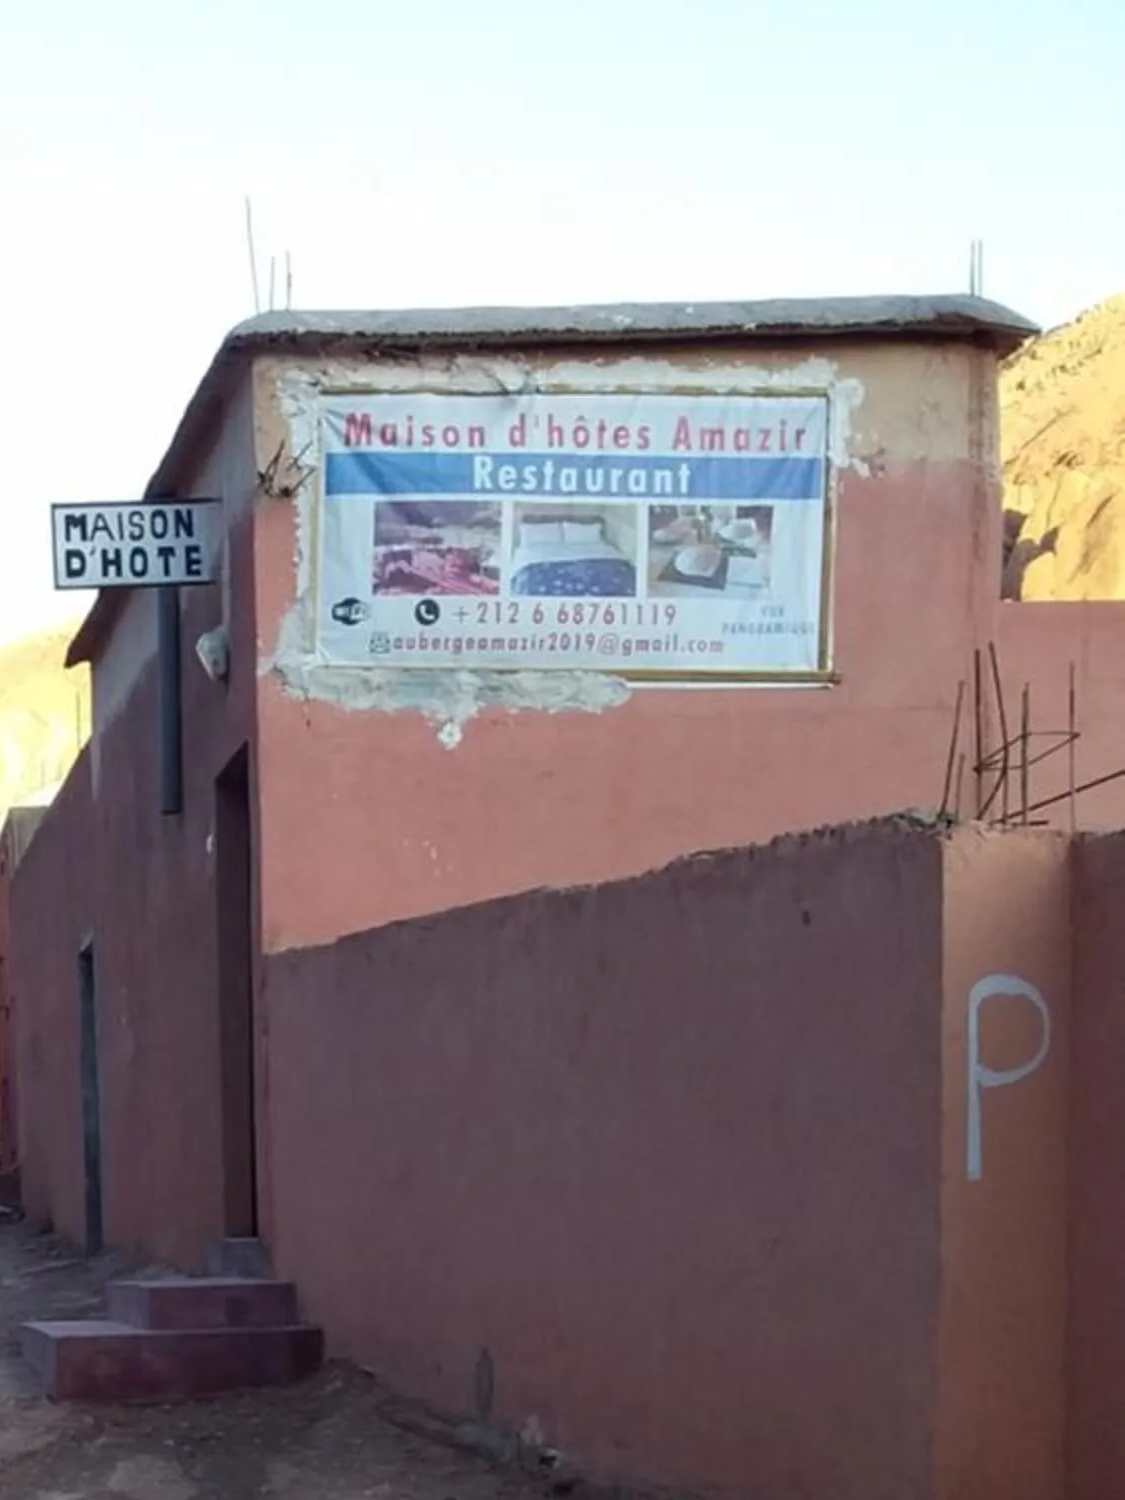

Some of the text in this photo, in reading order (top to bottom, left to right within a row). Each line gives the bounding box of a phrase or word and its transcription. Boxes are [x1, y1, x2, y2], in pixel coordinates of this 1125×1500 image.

[343, 412, 806, 451] Maison d'hôtes Amazir
[474, 455, 691, 494] Restaurant
[64, 509, 194, 541] MAISON
[65, 546, 202, 578] D'HOTE
[455, 602, 677, 626] +212 6 68761119
[967, 973, 1051, 1181] P
